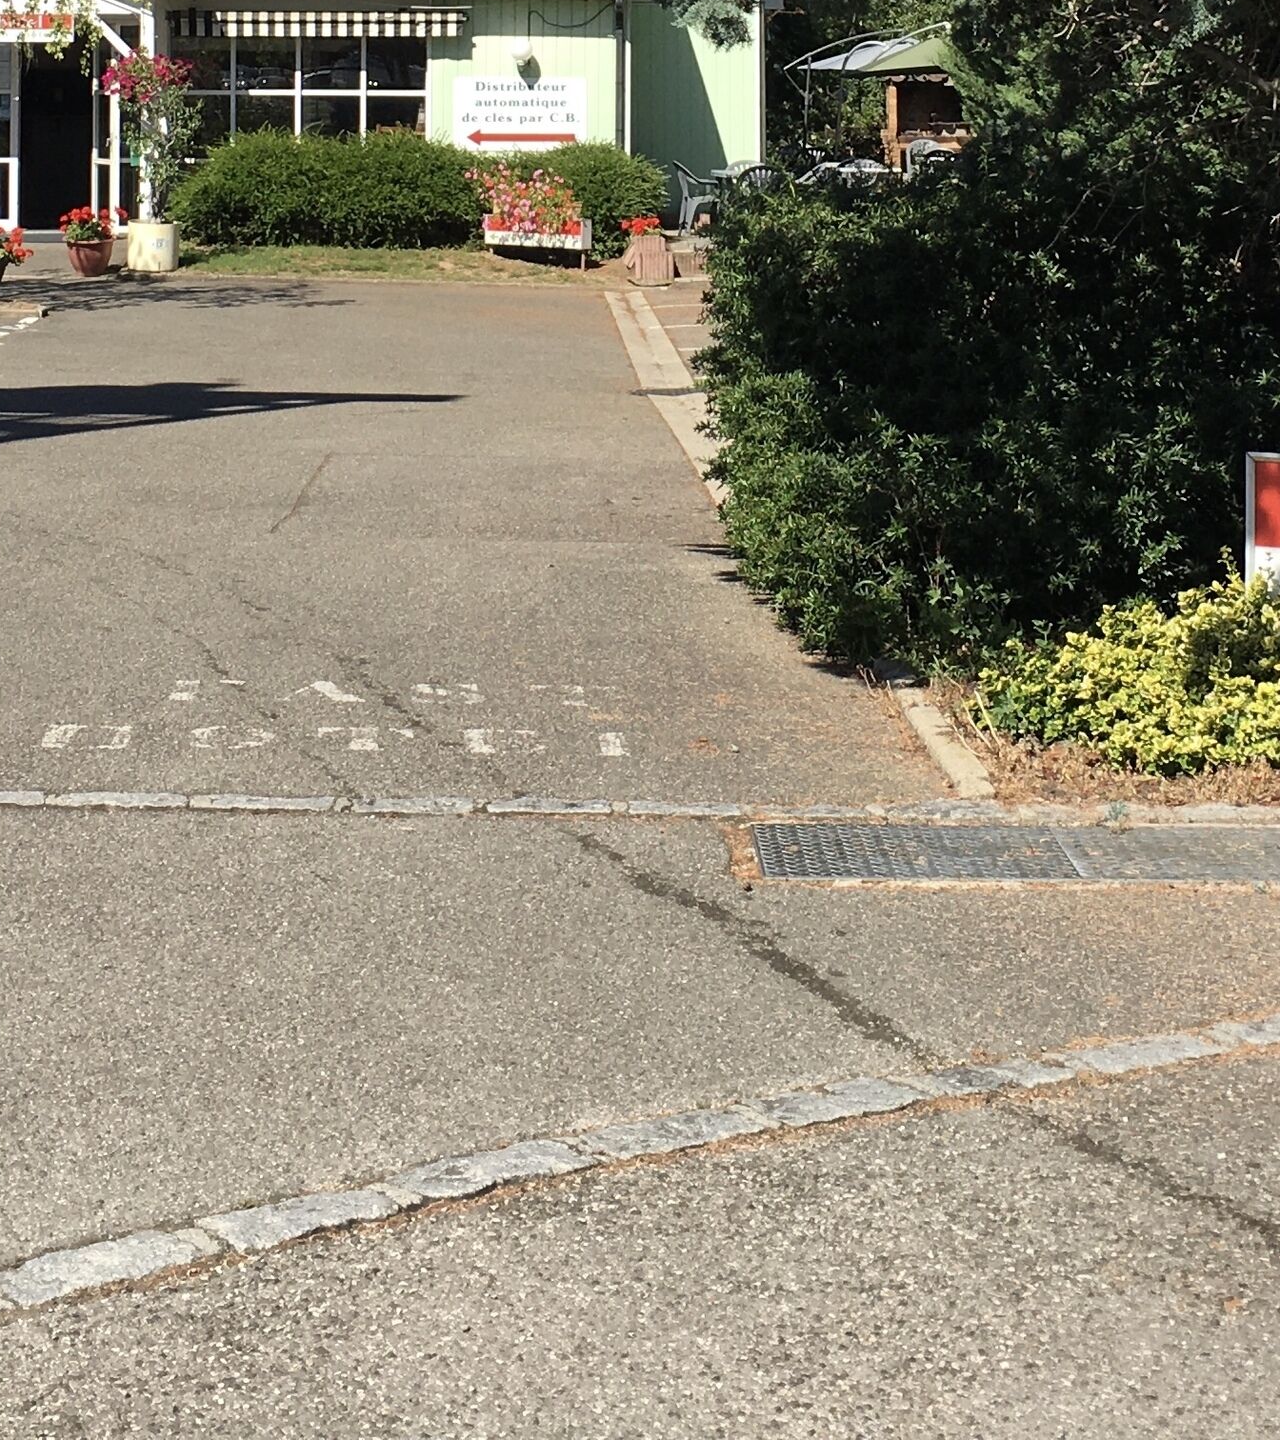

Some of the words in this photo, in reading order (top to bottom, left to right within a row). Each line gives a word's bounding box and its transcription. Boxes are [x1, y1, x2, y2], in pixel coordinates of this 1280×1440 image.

[475, 81, 567, 92] Distributeur
[475, 97, 567, 109] automatique
[461, 112, 478, 123] de
[519, 115, 543, 125] par
[549, 112, 581, 123] C.B.
